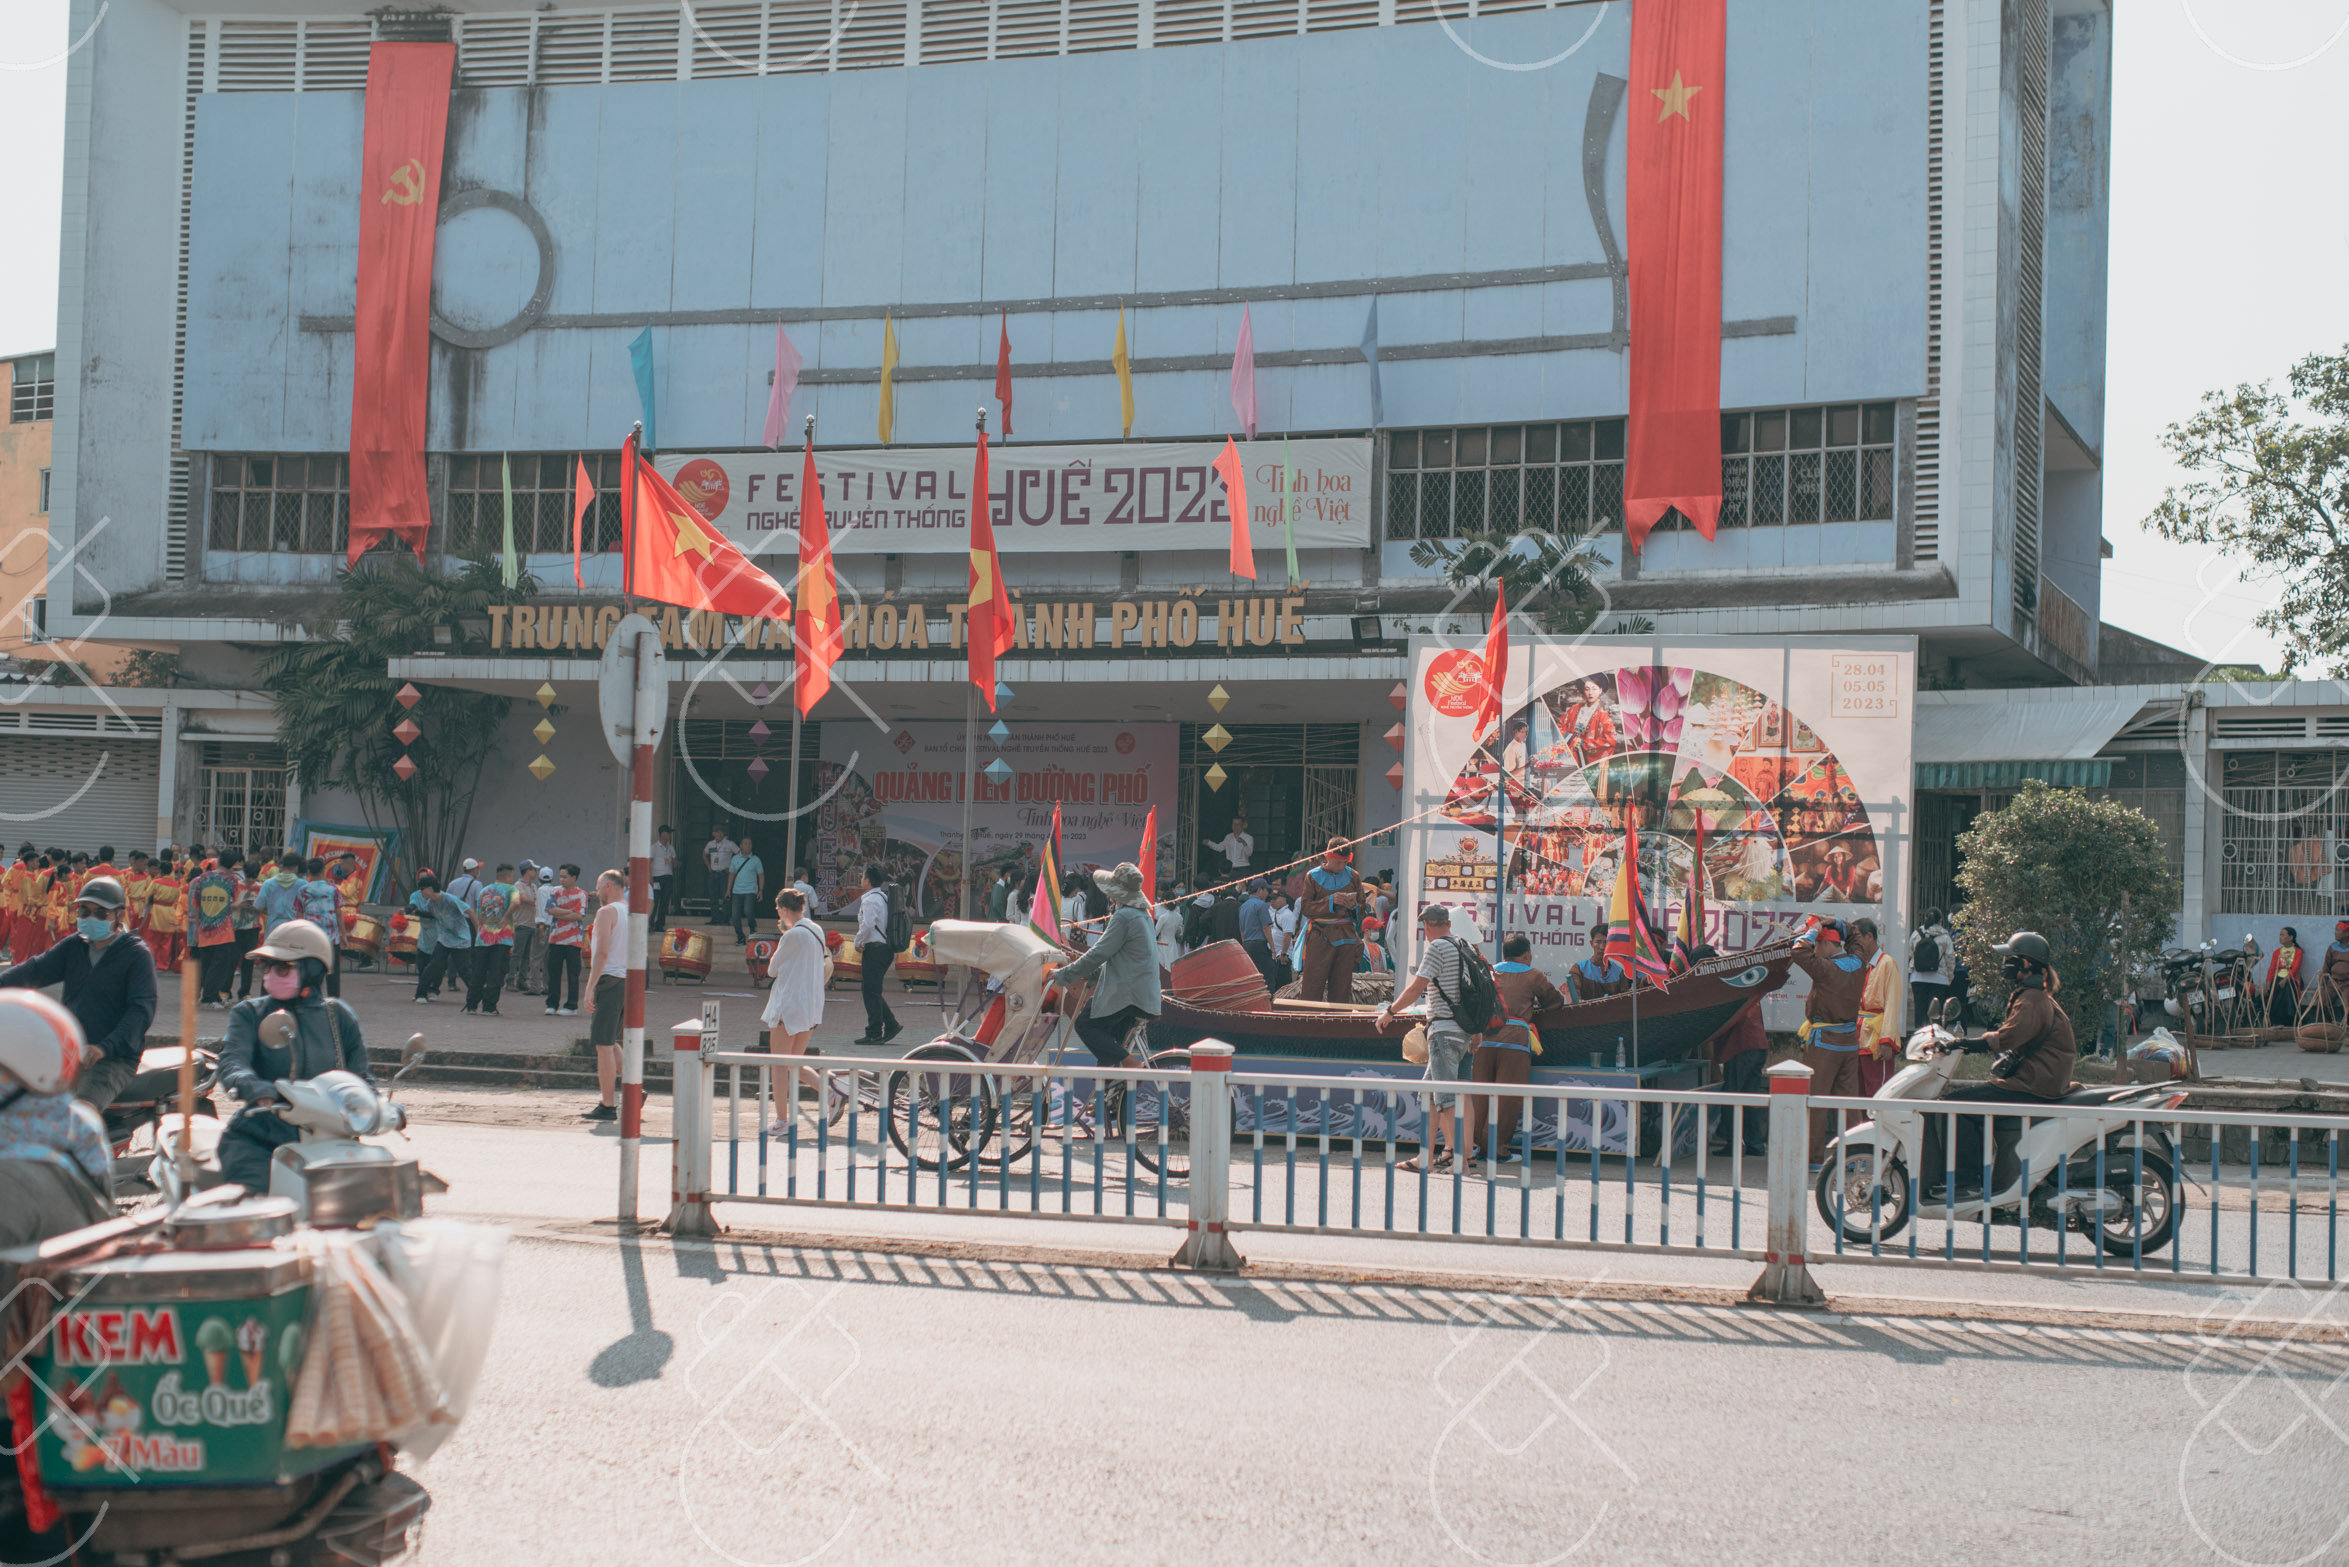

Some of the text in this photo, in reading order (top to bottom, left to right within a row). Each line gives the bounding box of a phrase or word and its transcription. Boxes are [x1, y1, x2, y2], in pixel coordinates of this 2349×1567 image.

[1255, 464, 1351, 496] Tih hoa
[824, 503, 889, 530] RUYỀN
[894, 503, 966, 529] THỐNG
[1306, 497, 1352, 526] Việt
[844, 589, 929, 650] HÓA
[946, 587, 1095, 650] TÀNH
[1112, 586, 1208, 649] PHỐ
[1217, 579, 1312, 648] HUẾ
[1843, 663, 1886, 676] 28.04
[1843, 680, 1885, 693] 05.05
[1842, 697, 1884, 710] 2023
[874, 760, 953, 804] QUẢNG
[1016, 762, 1097, 804] ĐƯỜNG
[1101, 762, 1152, 805] PHỐ
[1417, 901, 1586, 926] FSTIVAL
[1529, 928, 1585, 946] THỐNG
[57, 1308, 186, 1368] KEM
[202, 1379, 276, 1428] Quế
